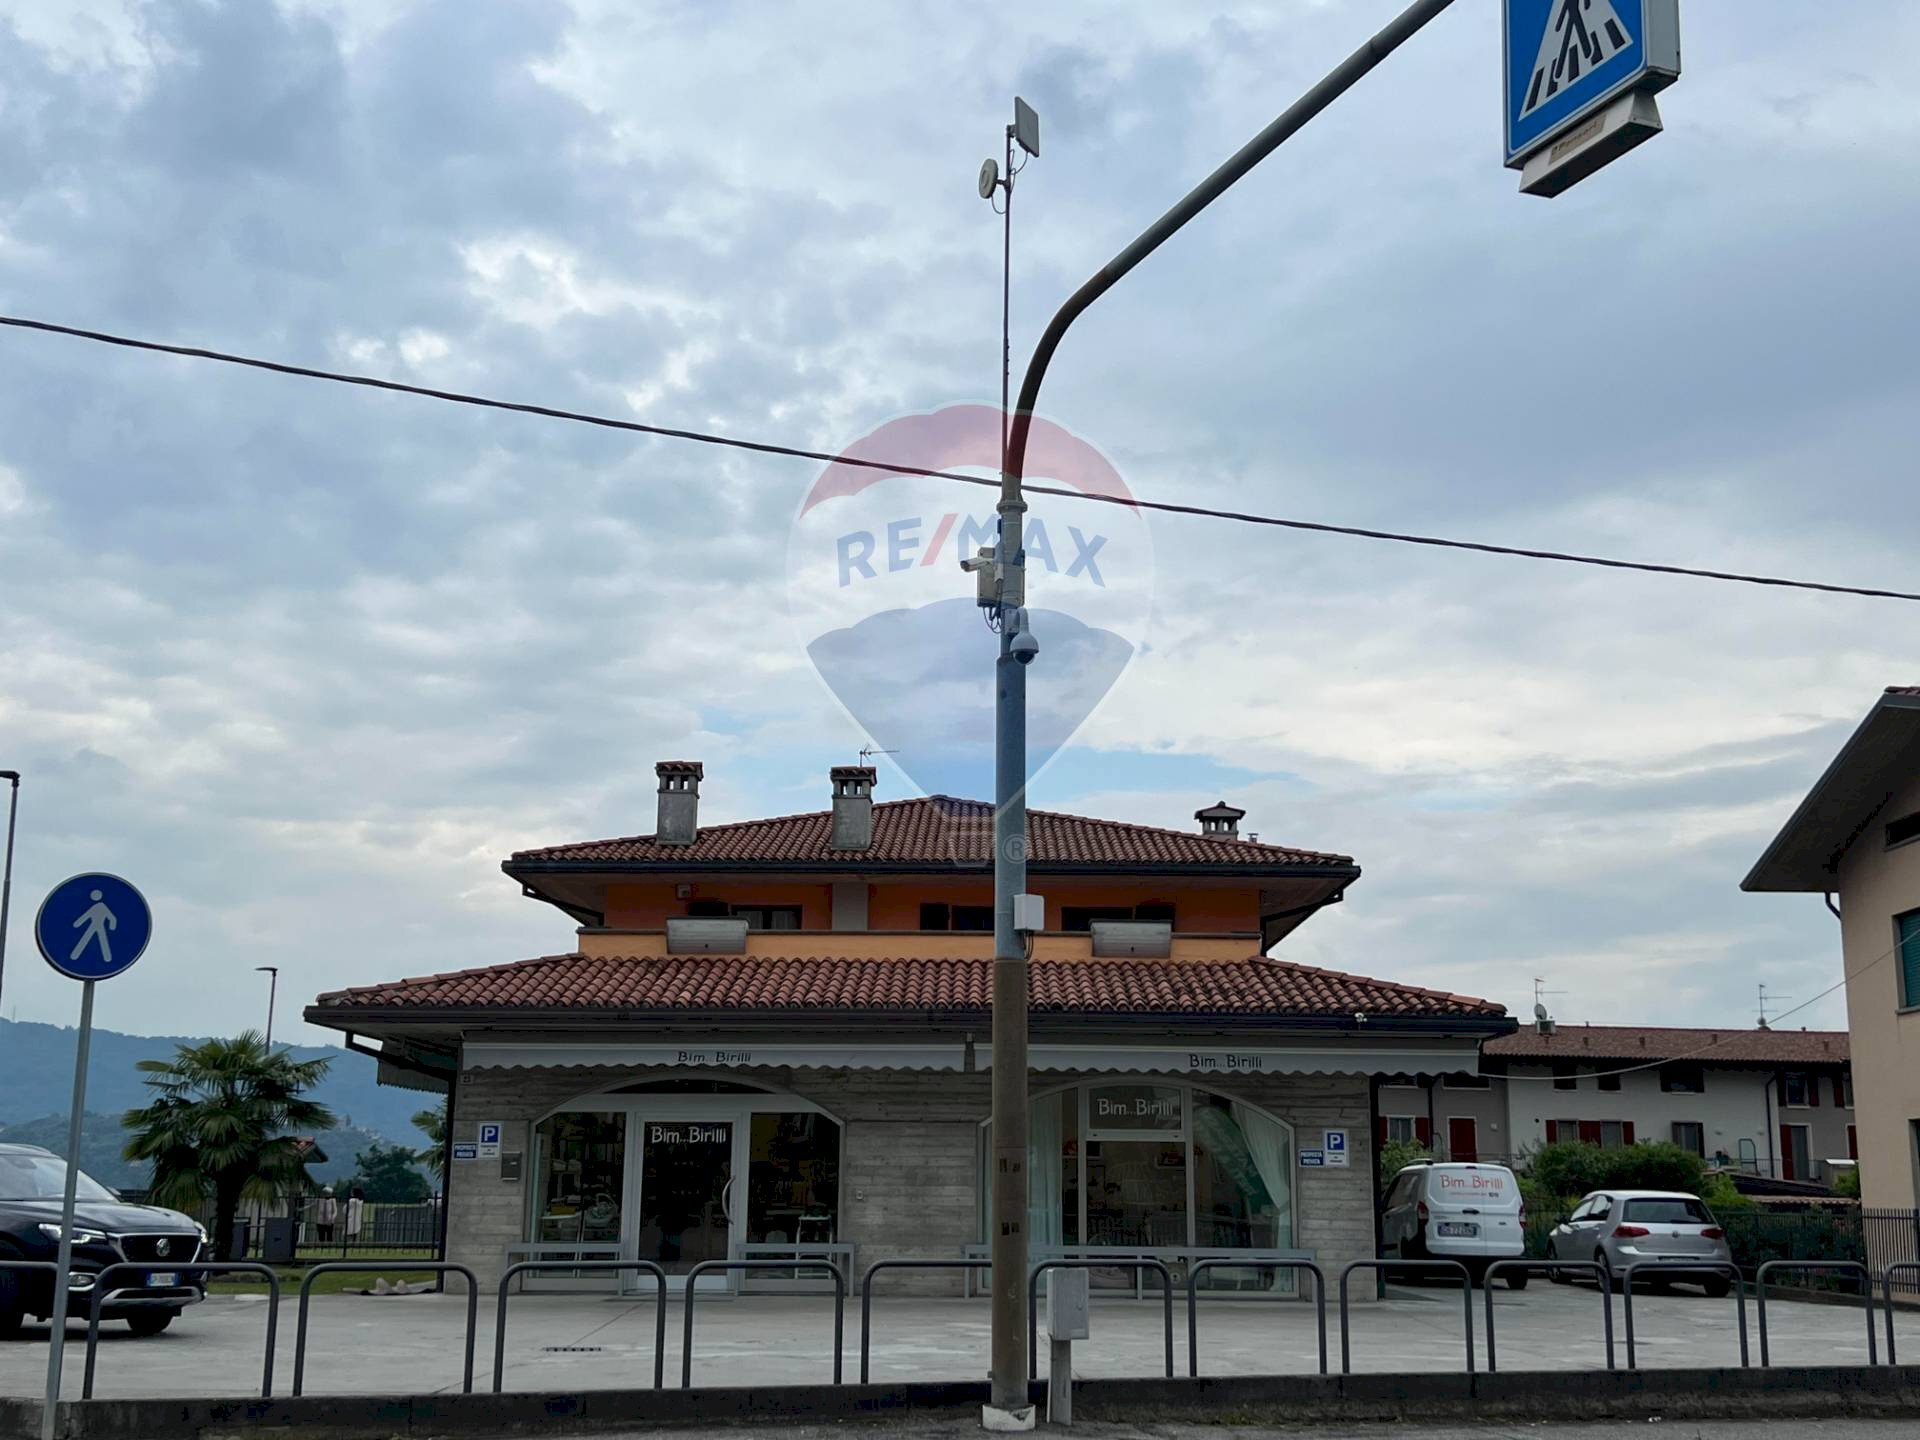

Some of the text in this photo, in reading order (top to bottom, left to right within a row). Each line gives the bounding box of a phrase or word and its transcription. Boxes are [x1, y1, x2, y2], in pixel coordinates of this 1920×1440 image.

[678, 1051, 752, 1063] Bim Birilli
[484, 1127, 496, 1141] P
[1330, 1134, 1341, 1149] P
